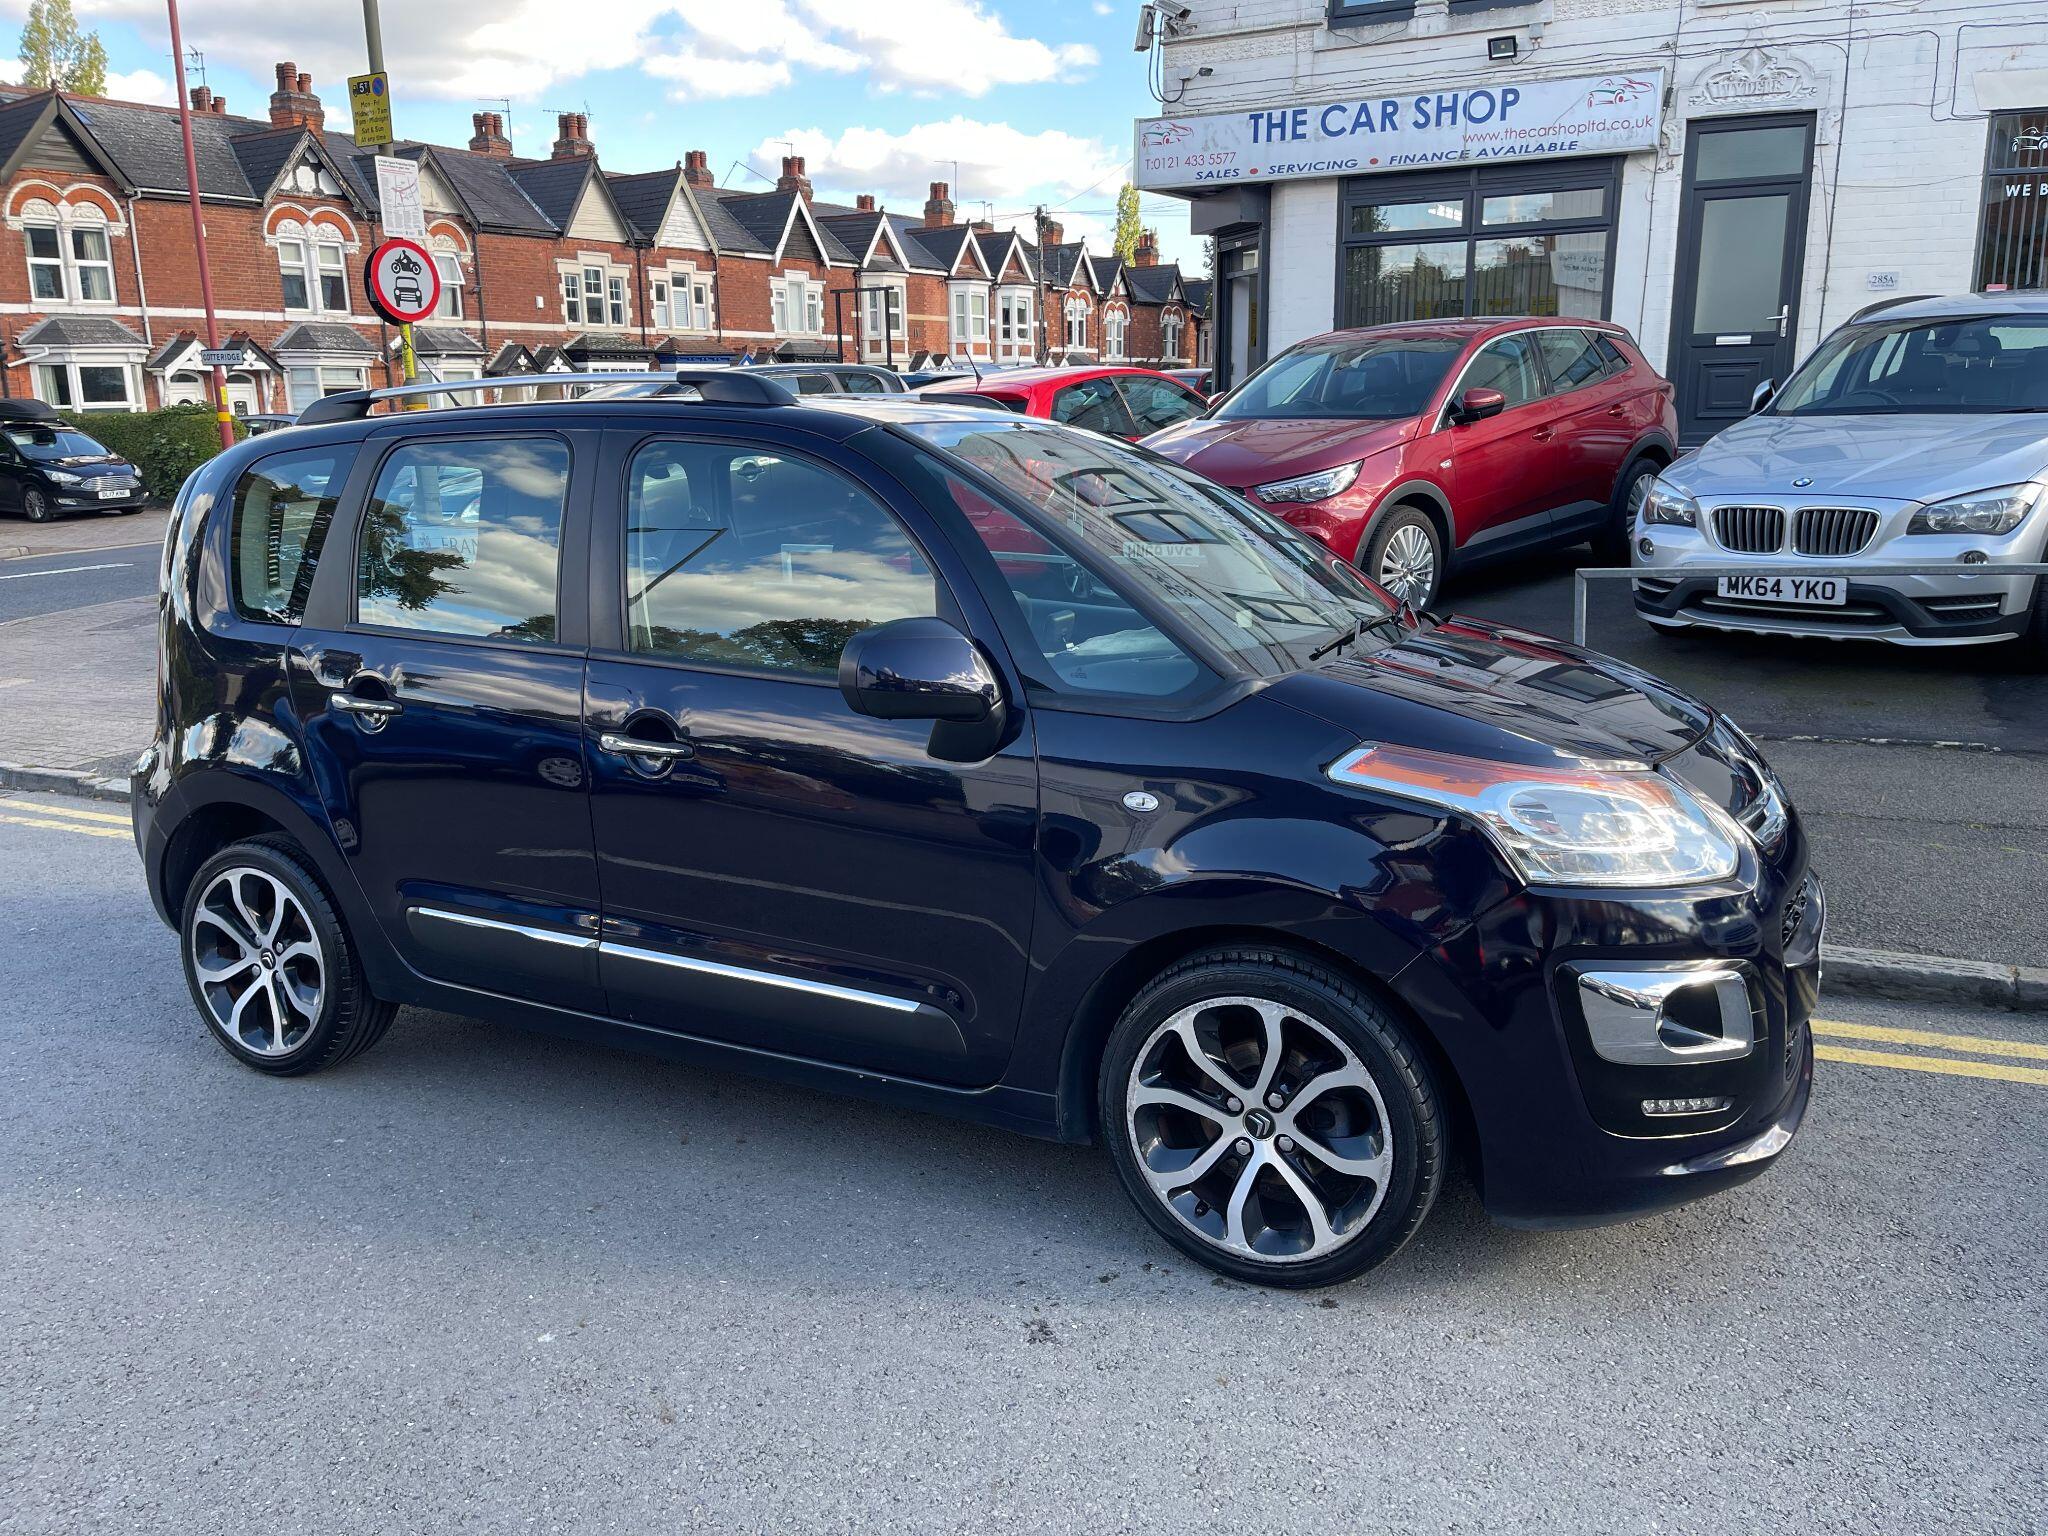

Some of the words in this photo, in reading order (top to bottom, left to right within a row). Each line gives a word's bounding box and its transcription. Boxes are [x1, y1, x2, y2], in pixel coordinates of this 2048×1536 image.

[1249, 108, 1308, 144] THE
[1320, 100, 1399, 137] CAR
[1412, 88, 1521, 130] SHOP
[1463, 114, 1654, 144] www.thecarshopltd.co.uk
[1144, 156, 1179, 170] T:0121
[1184, 154, 1205, 166] 433
[1208, 152, 1237, 165] 5577
[1195, 168, 1240, 180] SALES
[1268, 159, 1359, 175] SERVICING
[1389, 149, 1470, 165] FINANCE
[1475, 140, 1579, 158] AVAILABLE
[2005, 183, 2032, 197] WE
[1871, 275, 1894, 284] 285A
[203, 353, 240, 361] COTTERIDGE
[1727, 576, 1783, 598] MK64
[1791, 579, 1836, 601] YKO
